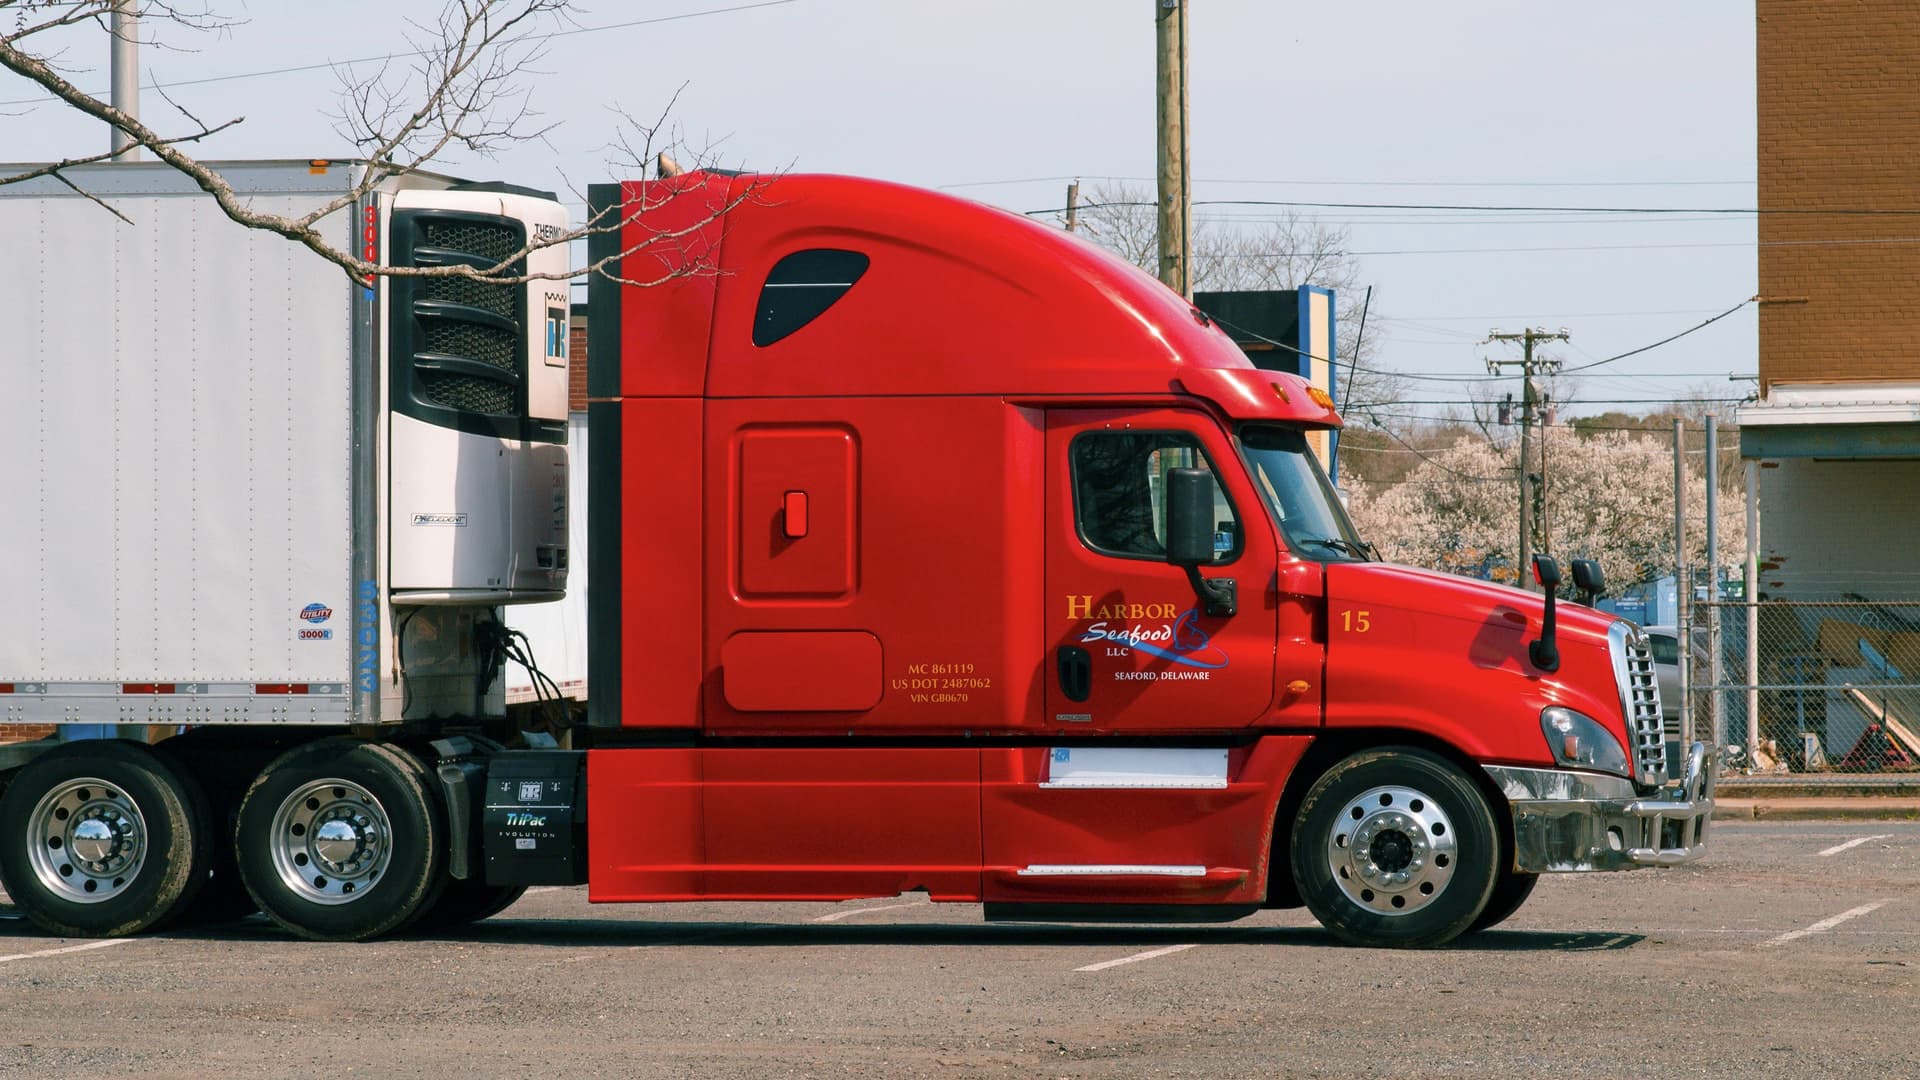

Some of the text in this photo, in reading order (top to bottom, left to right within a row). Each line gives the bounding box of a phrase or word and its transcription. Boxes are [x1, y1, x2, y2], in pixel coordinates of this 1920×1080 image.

[1066, 595, 1177, 620] HARBOR
[301, 609, 331, 619] UTILITY
[1340, 610, 1370, 632] 15
[1081, 622, 1172, 647] Seafood
[1106, 648, 1129, 657] LLC
[908, 663, 974, 674] MC 861119
[1114, 672, 1210, 682] SEAFORD, DELAWARE
[892, 678, 991, 689] US DOT 2487062
[910, 693, 928, 703] VIN
[506, 812, 547, 826] TriPac
